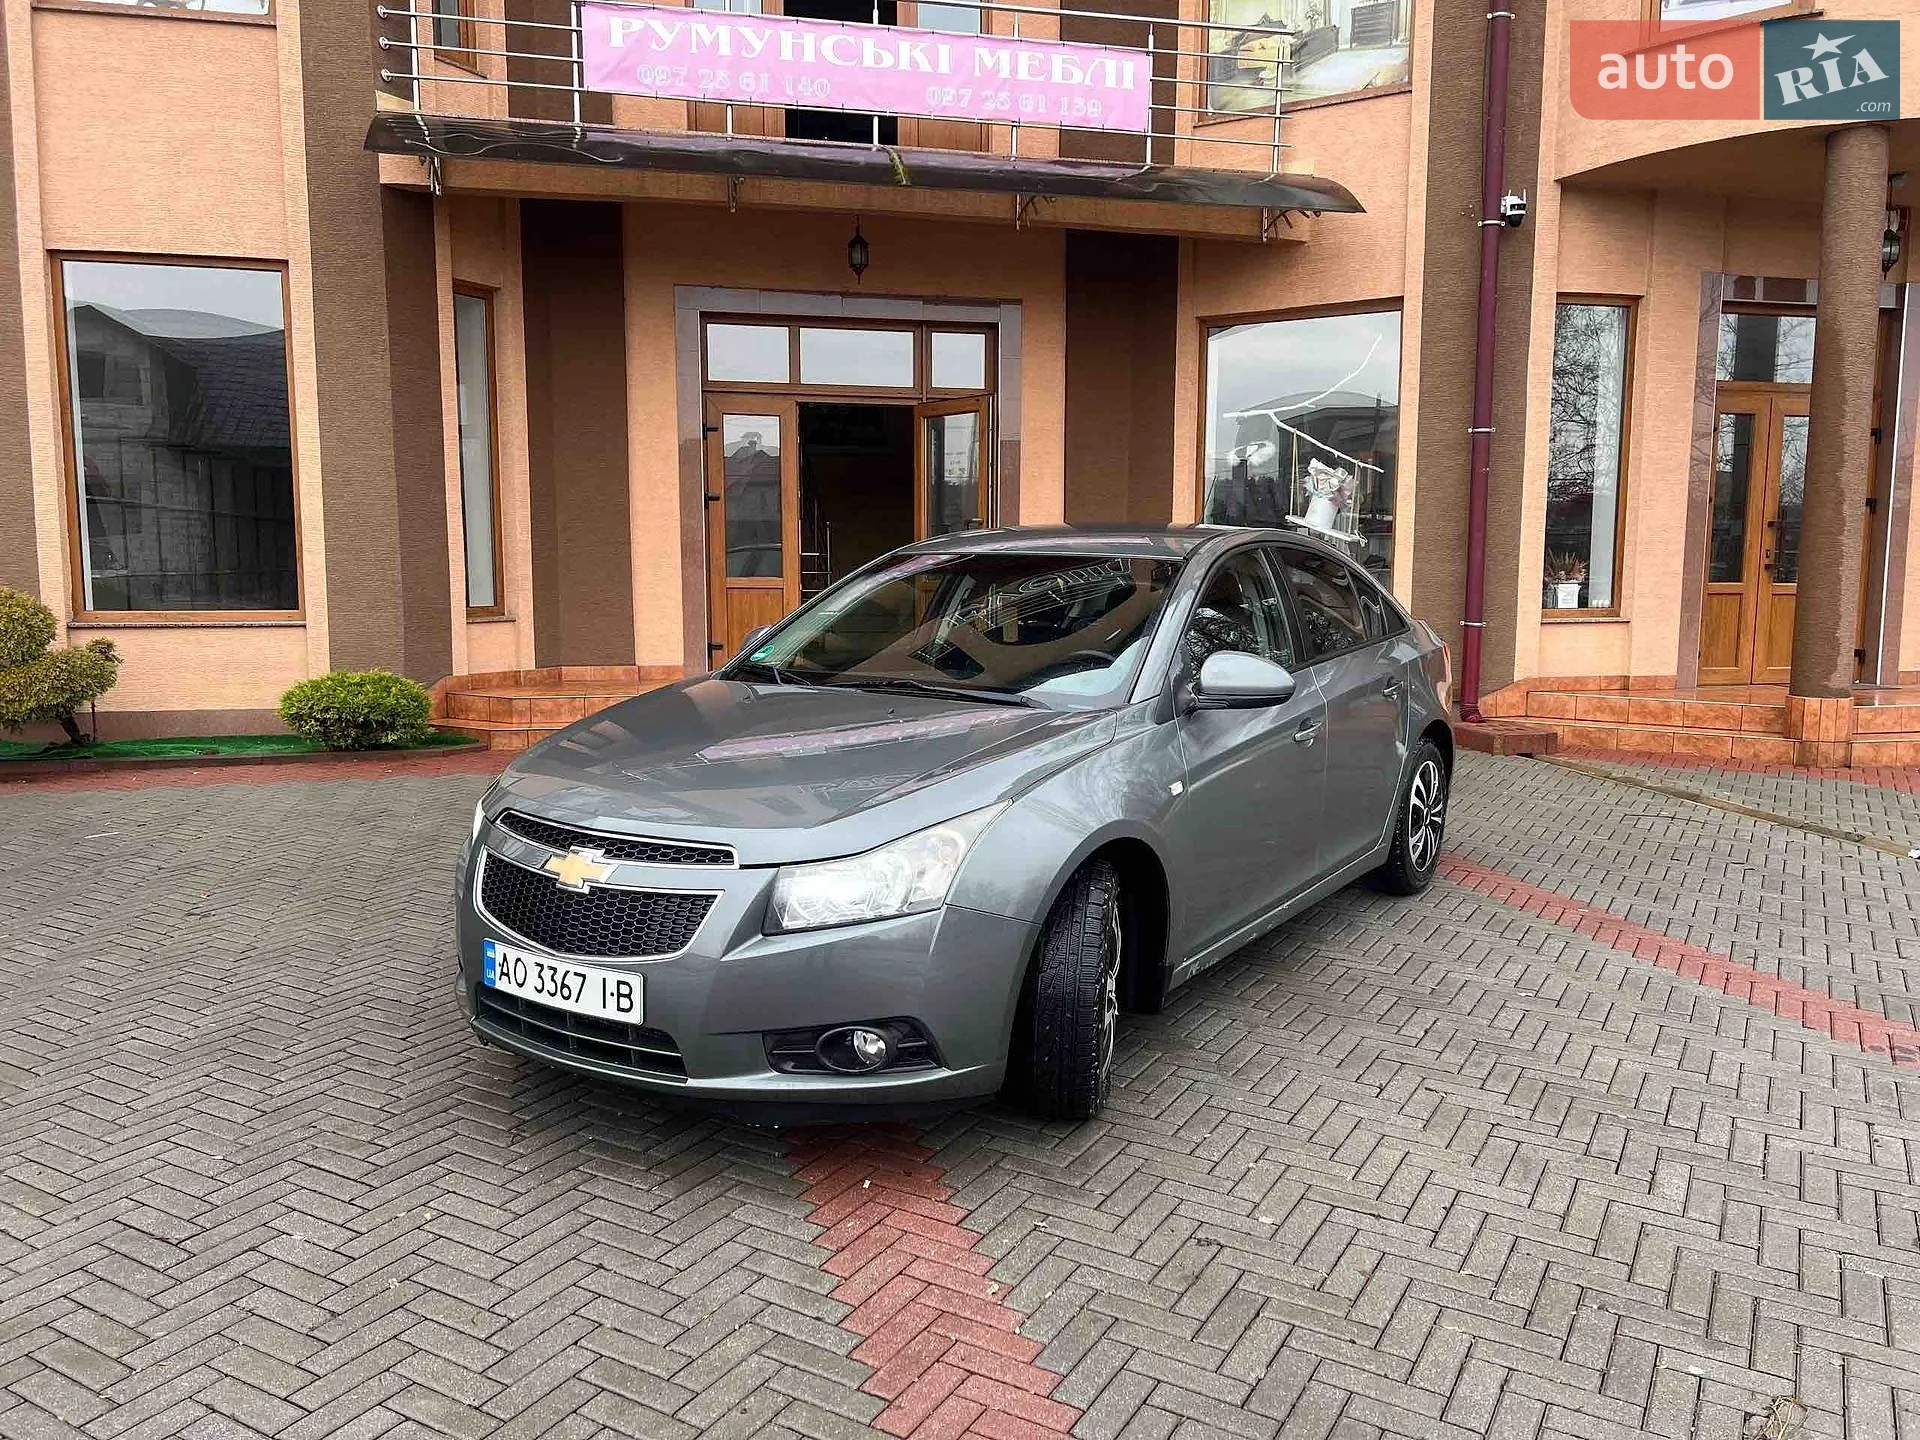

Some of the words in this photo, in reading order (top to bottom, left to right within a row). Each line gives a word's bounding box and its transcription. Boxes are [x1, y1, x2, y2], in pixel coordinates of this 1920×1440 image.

[609, 15, 952, 74] РУМУНСЬКІ
[973, 46, 1135, 90] МЕБЛІ
[486, 970, 495, 981] UA
[534, 961, 587, 1004] 3367
